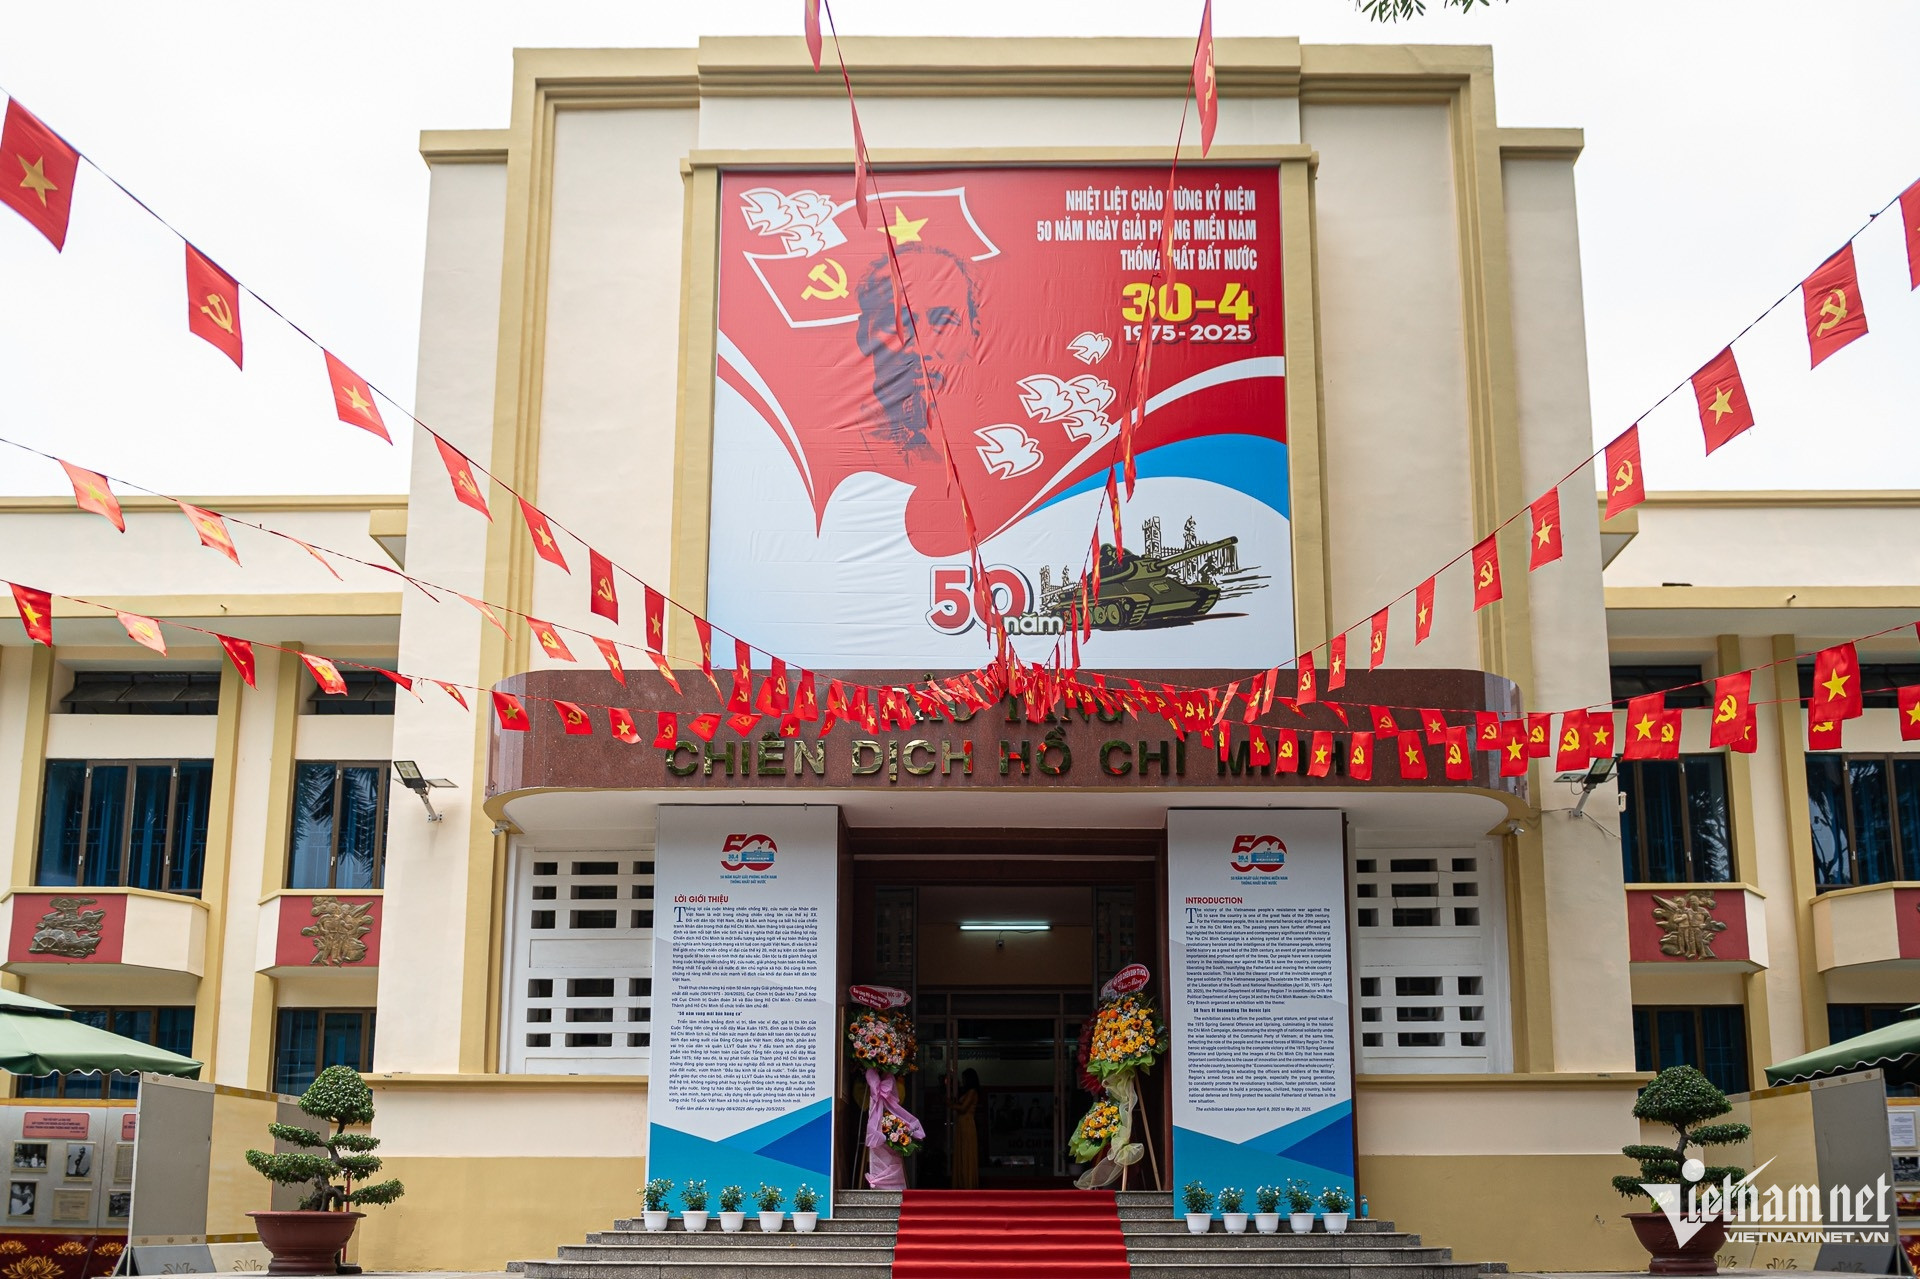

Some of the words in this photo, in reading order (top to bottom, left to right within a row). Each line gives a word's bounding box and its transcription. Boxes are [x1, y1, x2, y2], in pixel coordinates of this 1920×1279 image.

[1066, 186, 1100, 215] NHIỆT
[1104, 186, 1128, 215] LIỆT
[1131, 186, 1163, 211] CHÀO
[1205, 183, 1221, 211] KỶ
[1224, 186, 1256, 215] NIỆM
[1037, 220, 1051, 241] 50
[1055, 216, 1083, 241] NĂM
[1087, 216, 1118, 241] NGÀY
[1122, 213, 1146, 241] GIẢI
[1149, 219, 1191, 241] PHNG
[1194, 212, 1225, 240] MIỀN
[1229, 220, 1256, 240] NAM
[1120, 242, 1160, 270] THỐNG
[1163, 242, 1195, 270] HẤT
[1198, 242, 1221, 270] ĐẤT
[1224, 243, 1257, 270] NƯỚC
[928, 566, 1030, 633] 50
[1003, 612, 1064, 635] năm
[851, 739, 973, 782] DỊCH
[1000, 726, 1072, 775] HỒ
[674, 893, 687, 903] LỜI
[688, 893, 707, 903] GIỚI
[707, 894, 729, 905] THIỆU
[1185, 896, 1243, 904] INTRODUCTION
